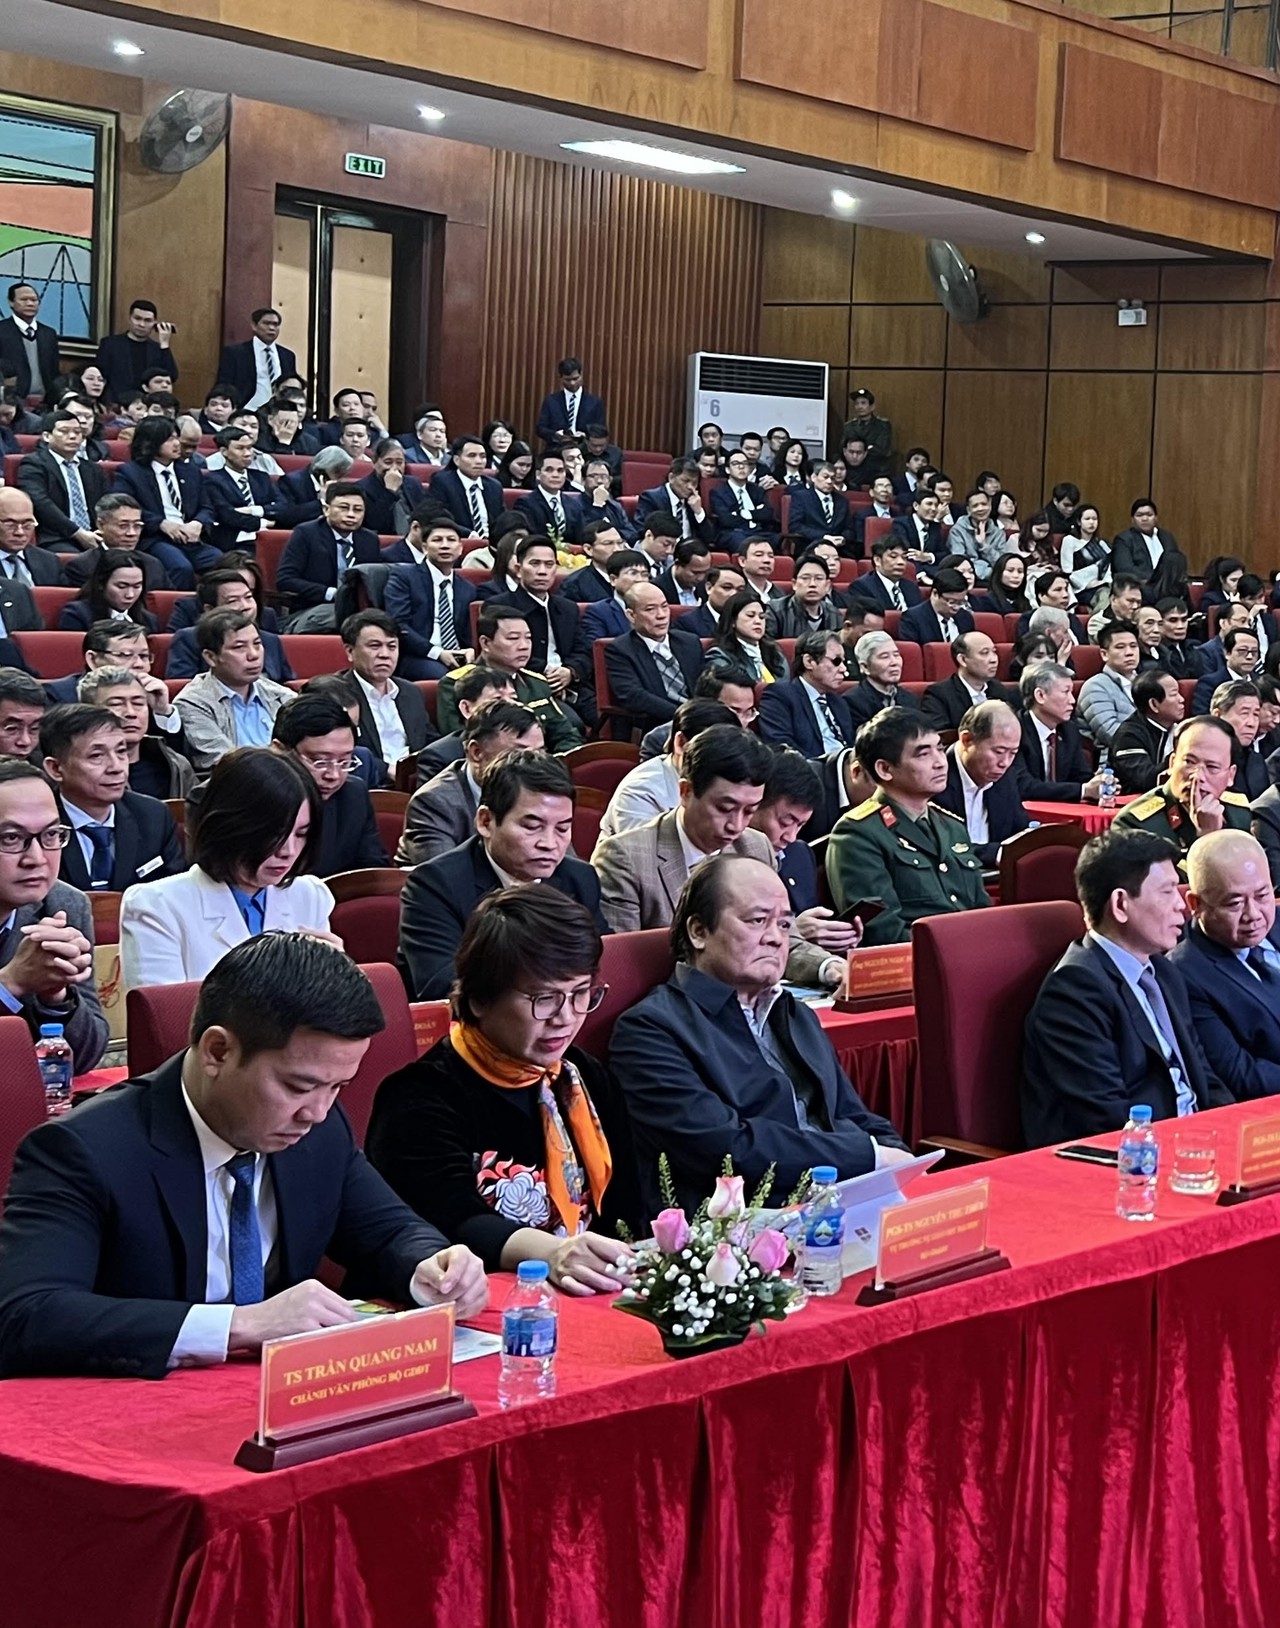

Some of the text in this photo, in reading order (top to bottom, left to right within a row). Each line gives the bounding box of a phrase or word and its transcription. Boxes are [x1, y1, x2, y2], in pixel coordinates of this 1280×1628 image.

[350, 157, 382, 174] EXIT
[710, 399, 720, 417] 6
[283, 1338, 438, 1386] TS TRẦN QUANG NAM
